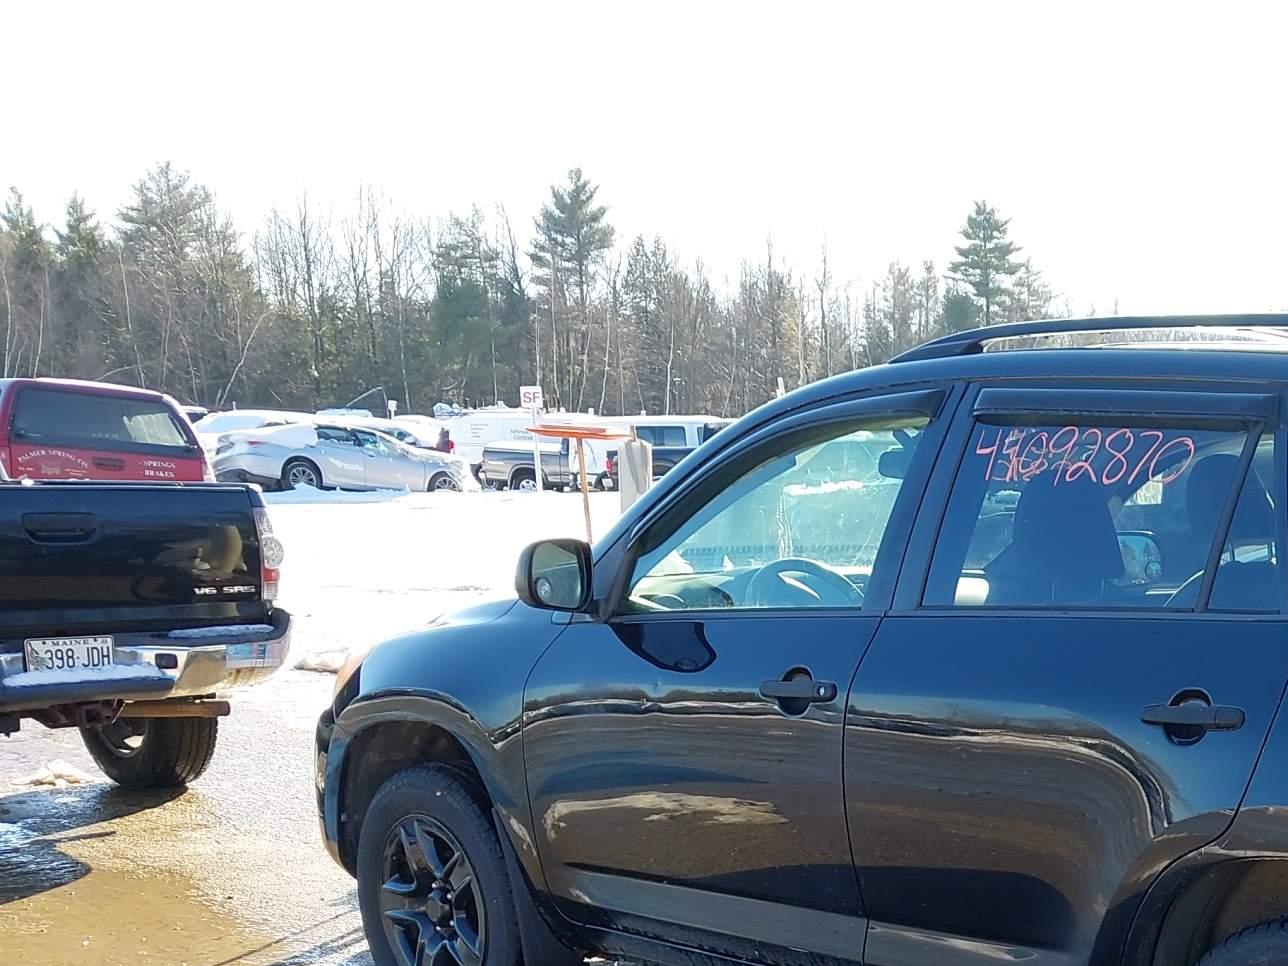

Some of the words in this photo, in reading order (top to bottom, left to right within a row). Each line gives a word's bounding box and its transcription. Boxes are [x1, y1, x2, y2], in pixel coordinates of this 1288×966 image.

[522, 391, 540, 404] SF
[17, 449, 46, 463] PALMER
[47, 449, 75, 461] SPRING
[143, 460, 176, 469] SPRINGS
[143, 469, 175, 478] BRAKES
[193, 587, 217, 595] V6
[51, 639, 90, 647] MAINE
